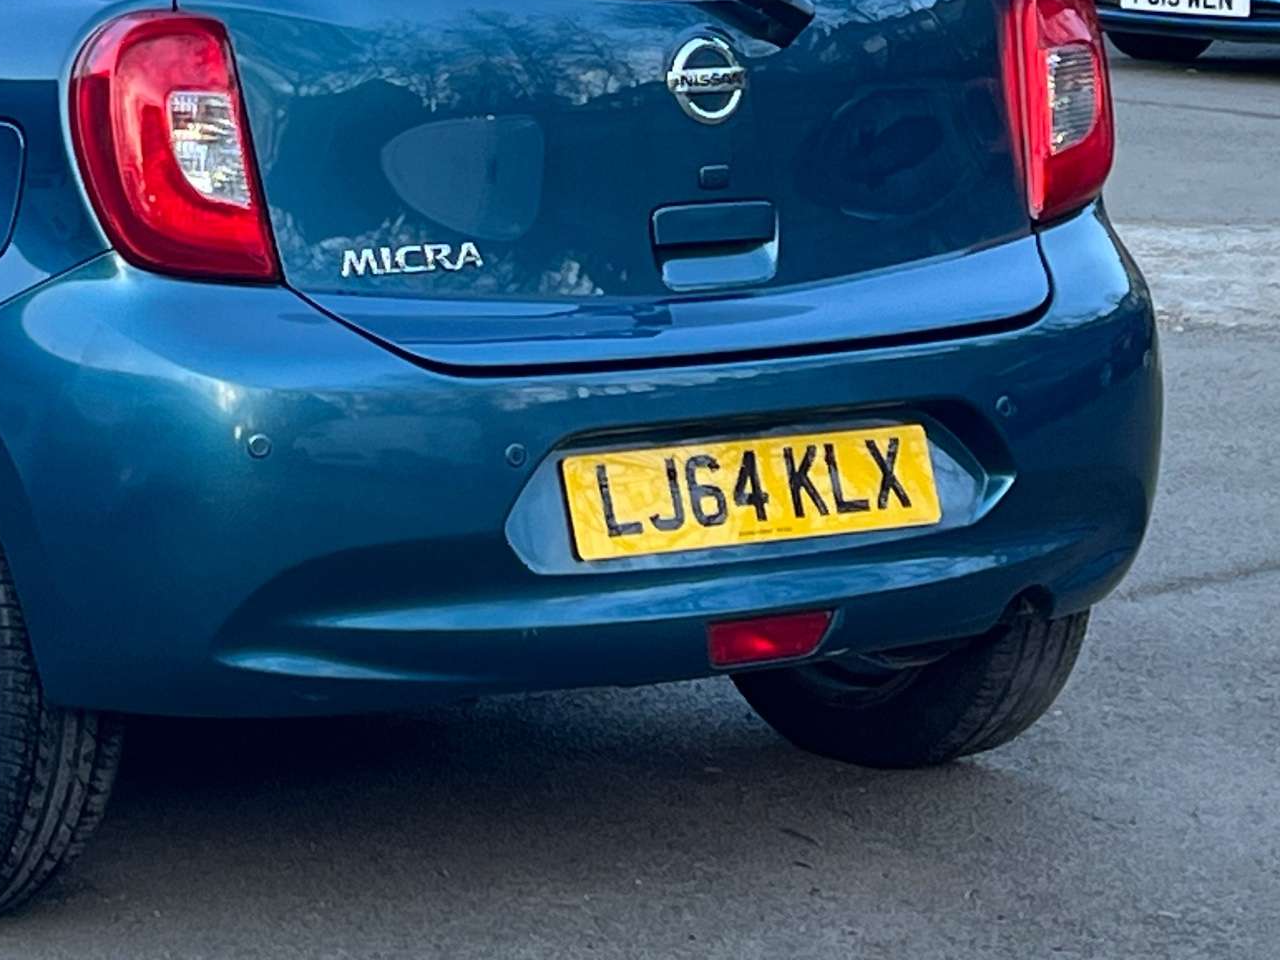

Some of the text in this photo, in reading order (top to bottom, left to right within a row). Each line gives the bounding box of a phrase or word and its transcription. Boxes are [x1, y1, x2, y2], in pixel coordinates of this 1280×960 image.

[679, 71, 744, 88] NISSAN
[341, 242, 484, 278] MICRA
[596, 437, 913, 538] LJ64 KLX
